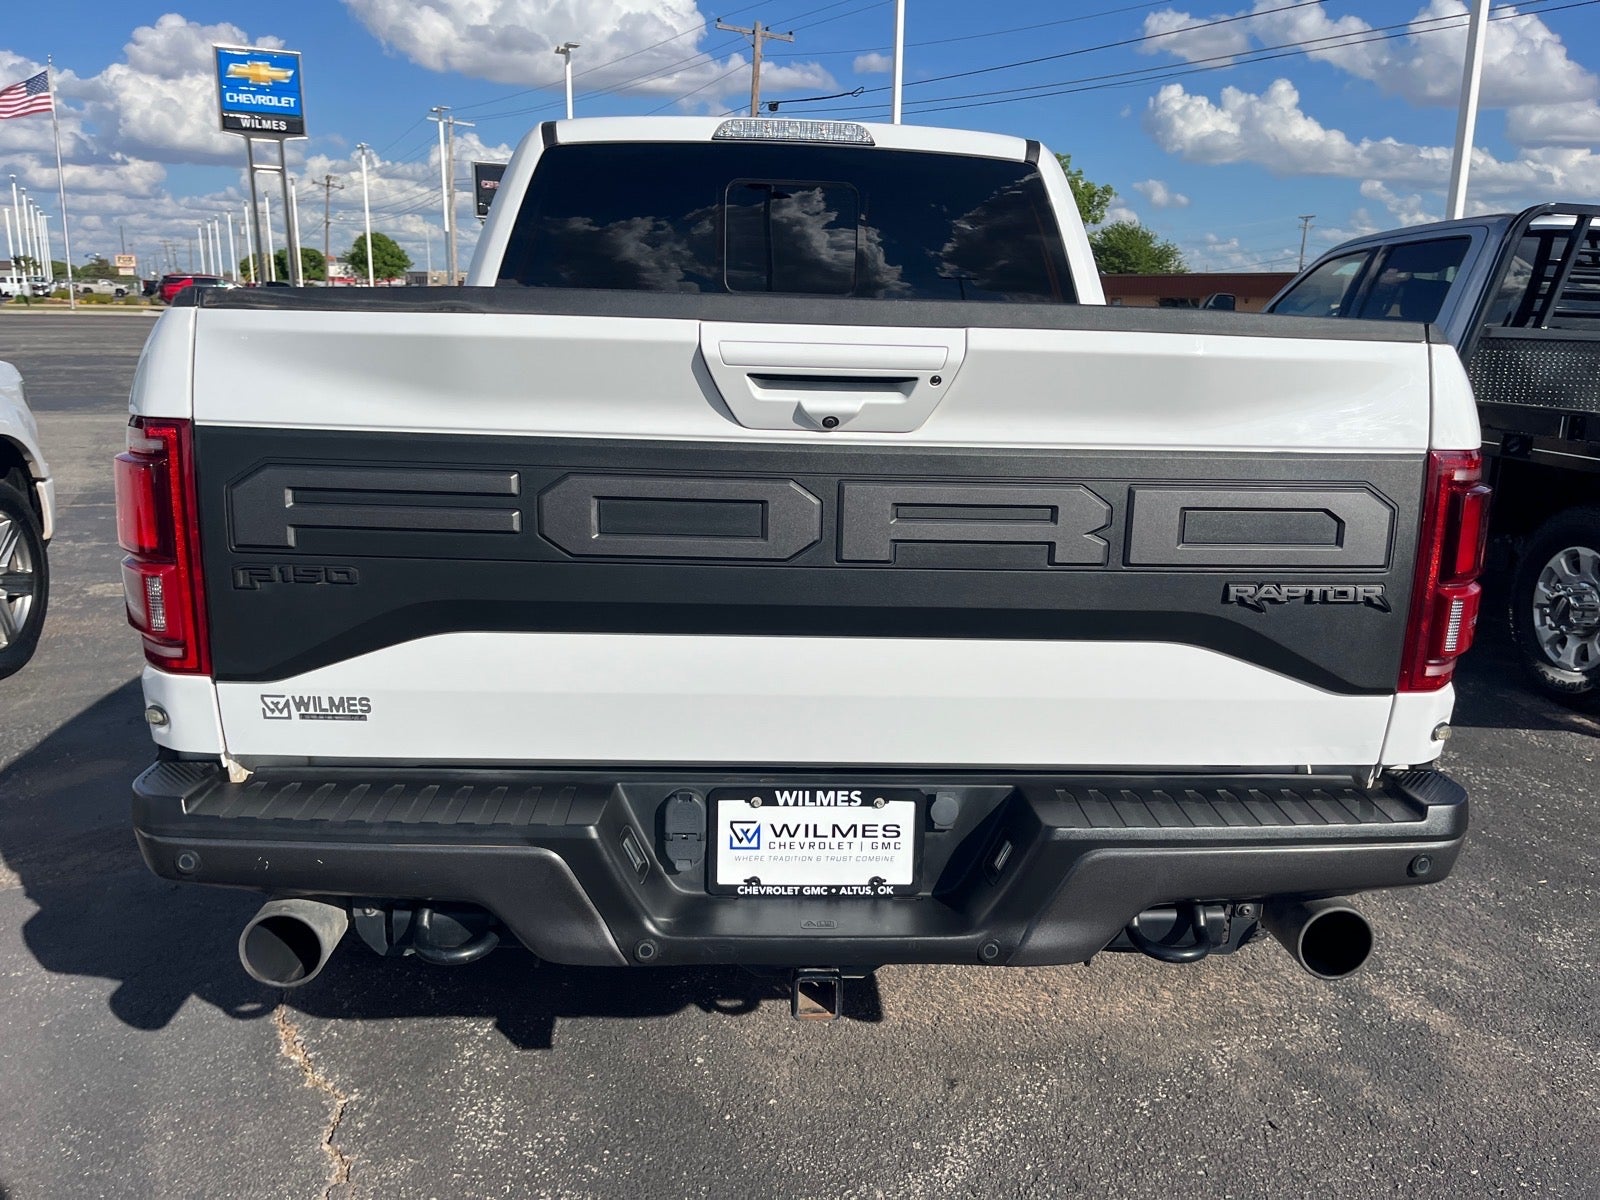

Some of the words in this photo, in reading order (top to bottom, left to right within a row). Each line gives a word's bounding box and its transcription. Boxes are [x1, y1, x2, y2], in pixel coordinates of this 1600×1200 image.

[225, 92, 296, 108] CHEVROLET
[240, 118, 287, 131] WILMES
[230, 461, 1394, 571] FORD
[1222, 582, 1391, 613] RAPTOR
[291, 695, 371, 714] WILMES
[774, 790, 862, 807] WILMES
[770, 823, 901, 838] WILMES
[768, 841, 853, 850] CHEVROLET
[871, 841, 901, 850] GMC
[737, 885, 800, 895] CHEVROLET
[802, 886, 828, 895] GMC
[839, 886, 875, 896] ALTUS,
[877, 886, 894, 895] OK
